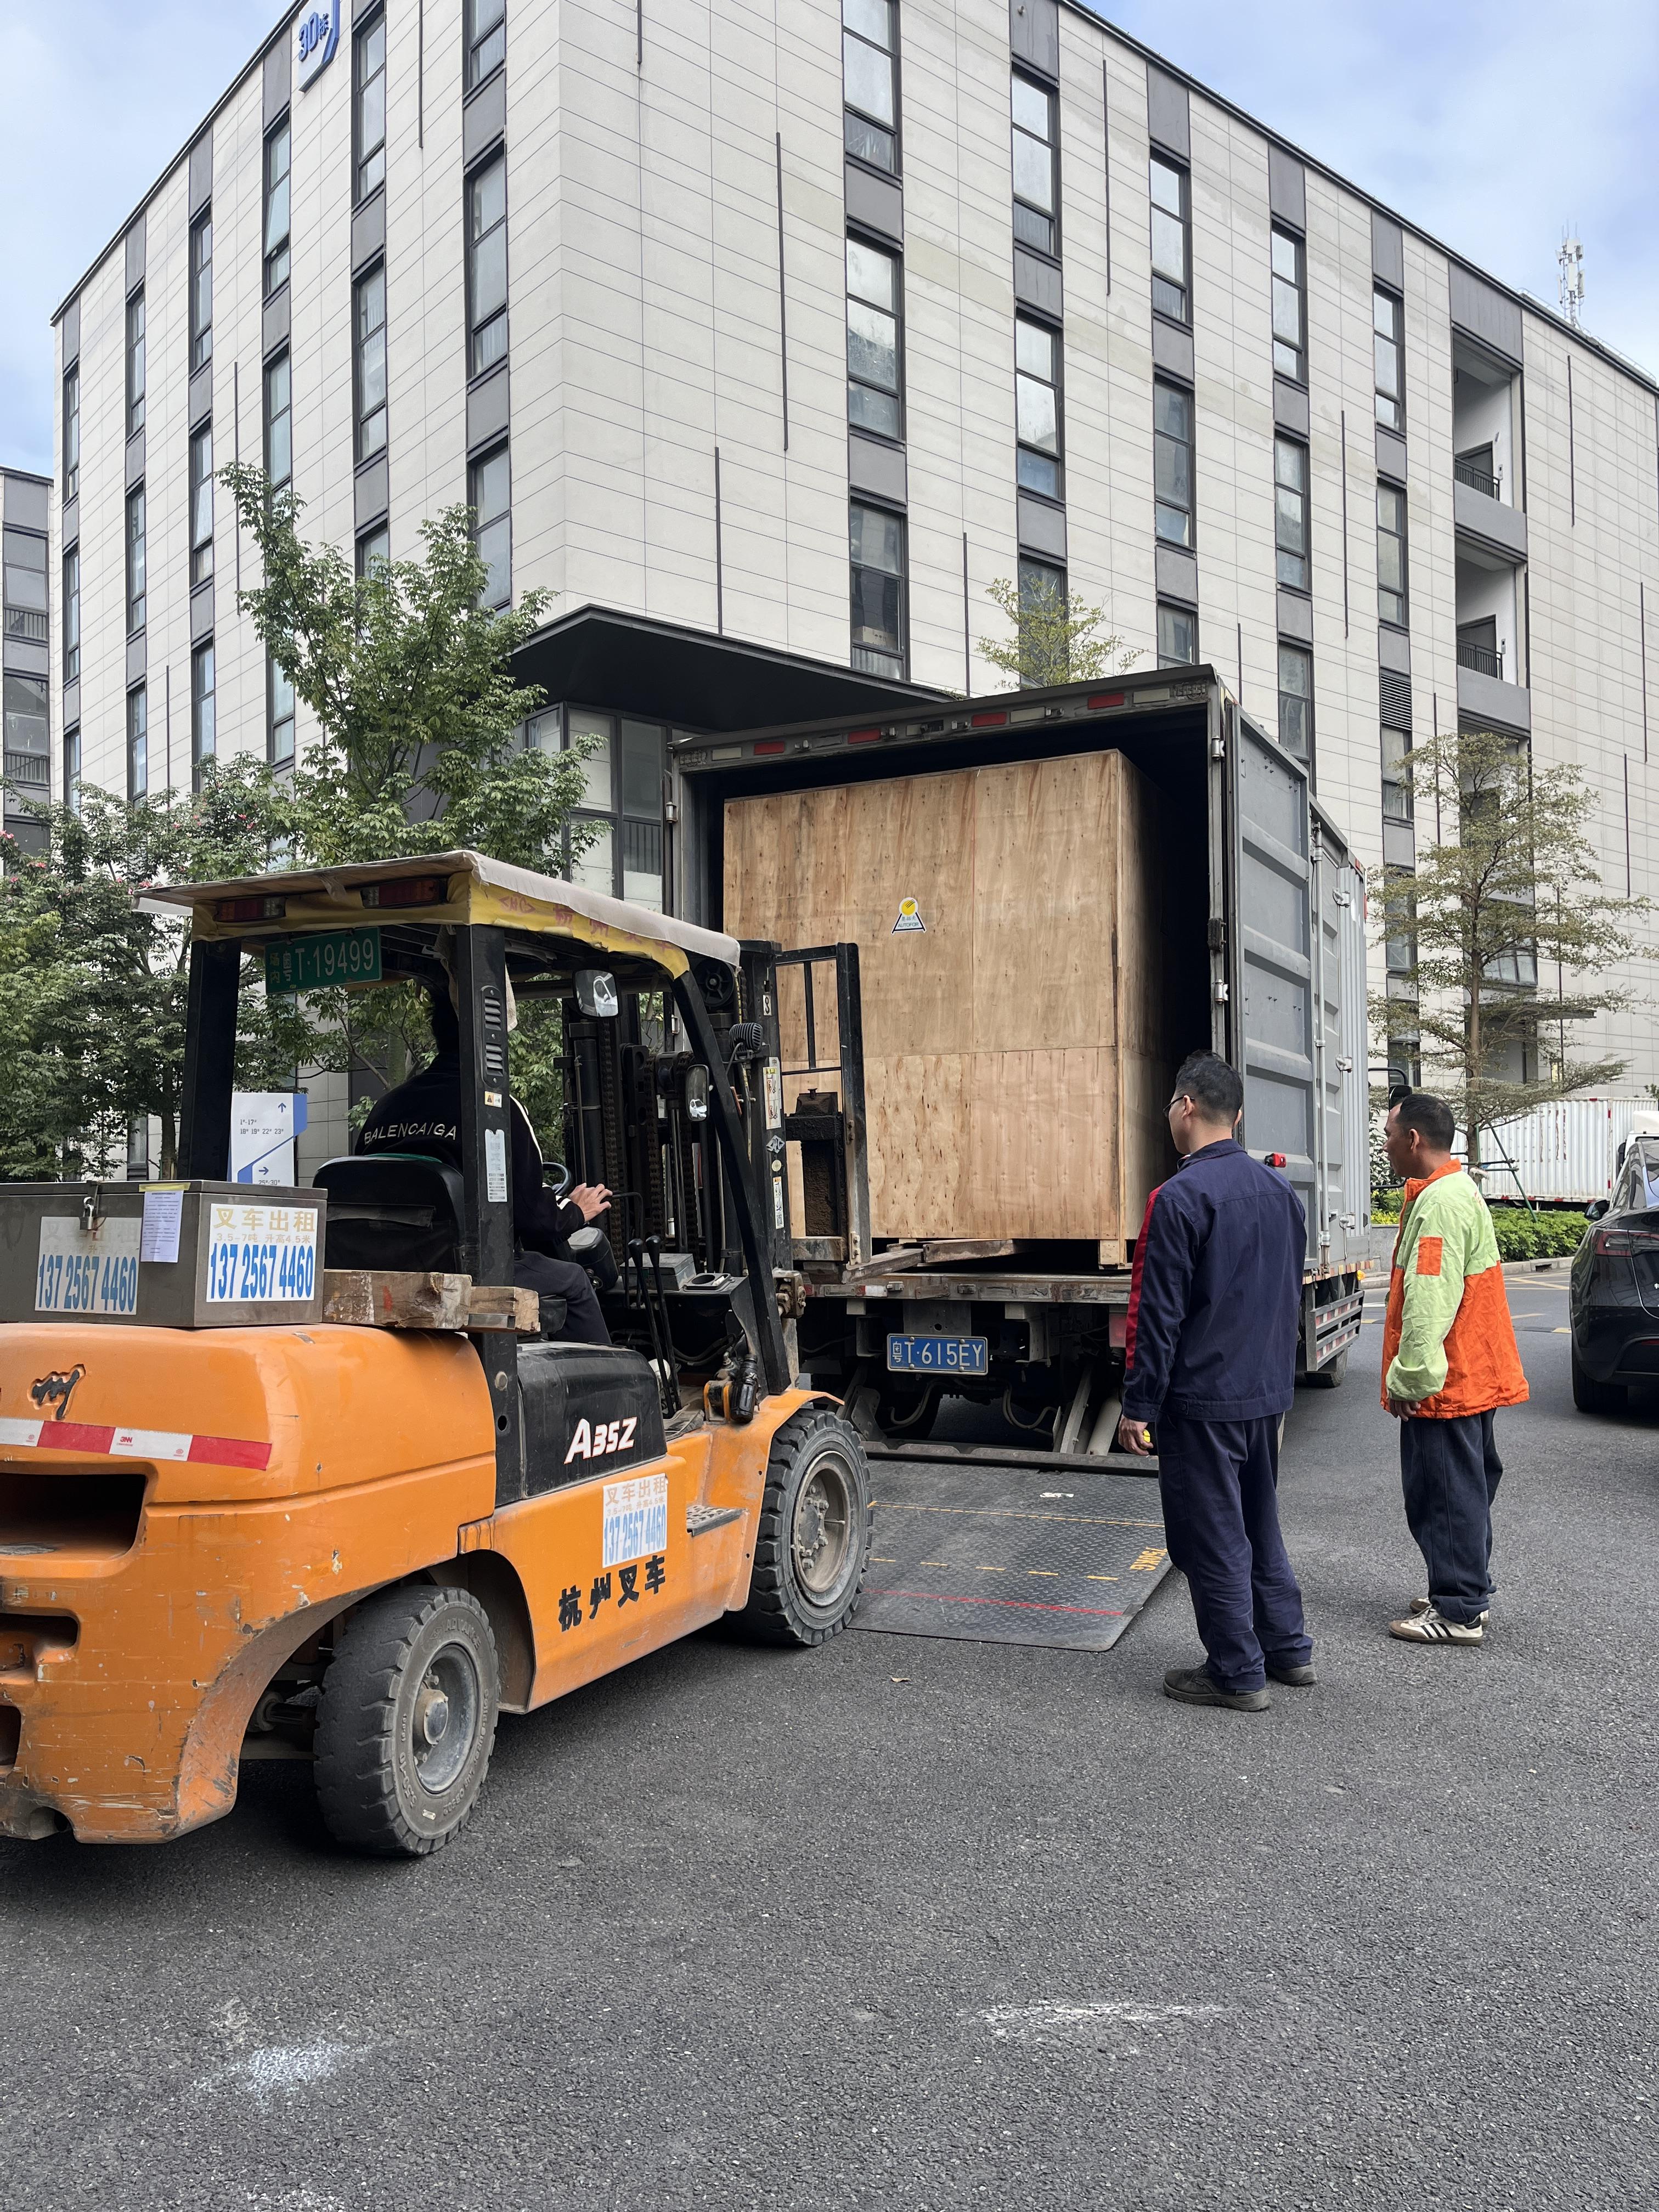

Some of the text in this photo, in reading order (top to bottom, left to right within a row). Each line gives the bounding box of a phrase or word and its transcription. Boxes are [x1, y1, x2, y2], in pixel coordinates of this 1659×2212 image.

[364, 1122, 456, 1145] BALENCAIGA
[213, 1208, 315, 1232] 叉车出租
[264, 1234, 311, 1244] 升高4.5米
[38, 1254, 137, 1312] 137 2567 4460
[211, 1243, 313, 1299] 137 2567 4460
[563, 1417, 637, 1465] A35Z
[606, 1476, 666, 1506] 叉车出租
[605, 1504, 666, 1565] 137 2567 4460
[558, 1555, 665, 1632] 杭州叉车
